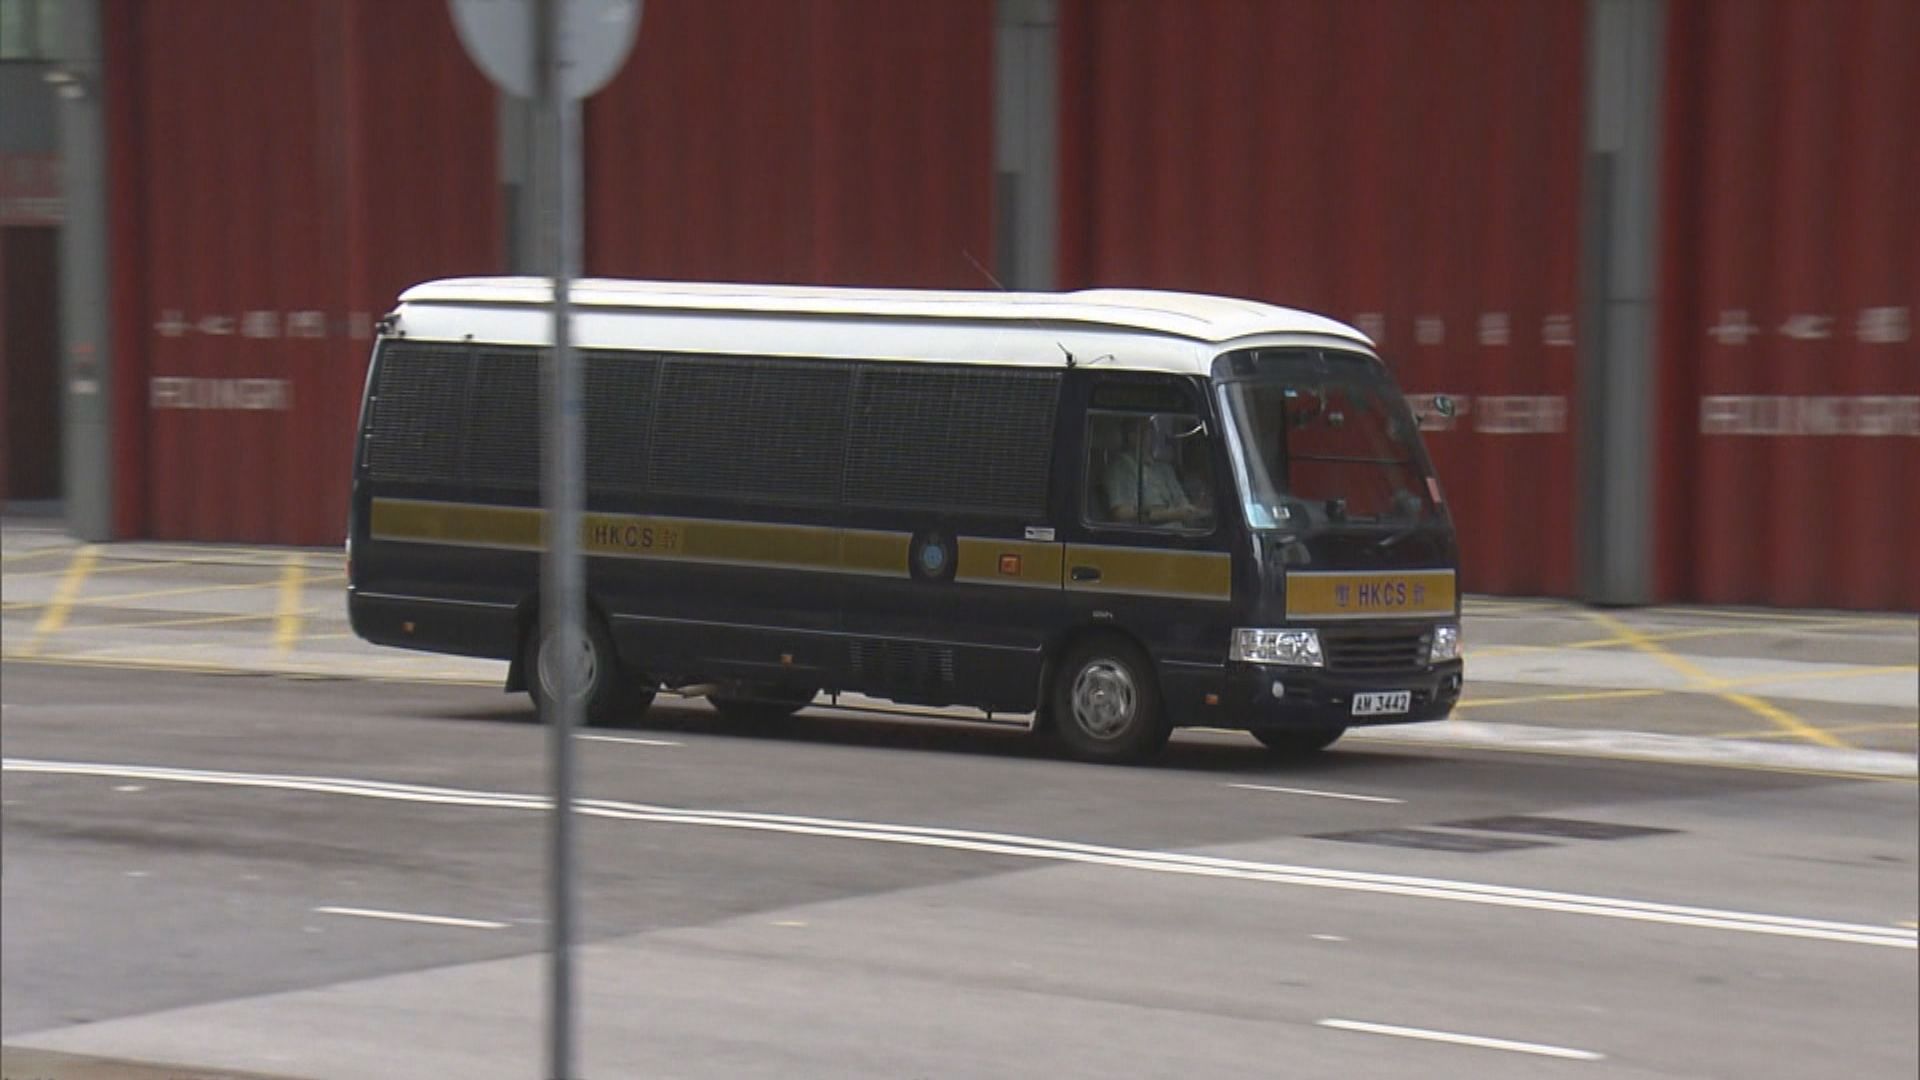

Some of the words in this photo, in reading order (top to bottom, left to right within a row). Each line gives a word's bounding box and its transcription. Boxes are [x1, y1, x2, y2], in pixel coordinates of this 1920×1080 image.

[594, 525, 654, 548] HKCS
[1358, 582, 1407, 607] HKCS
[1355, 695, 1372, 711] AM
[1376, 694, 1408, 711] 3442
